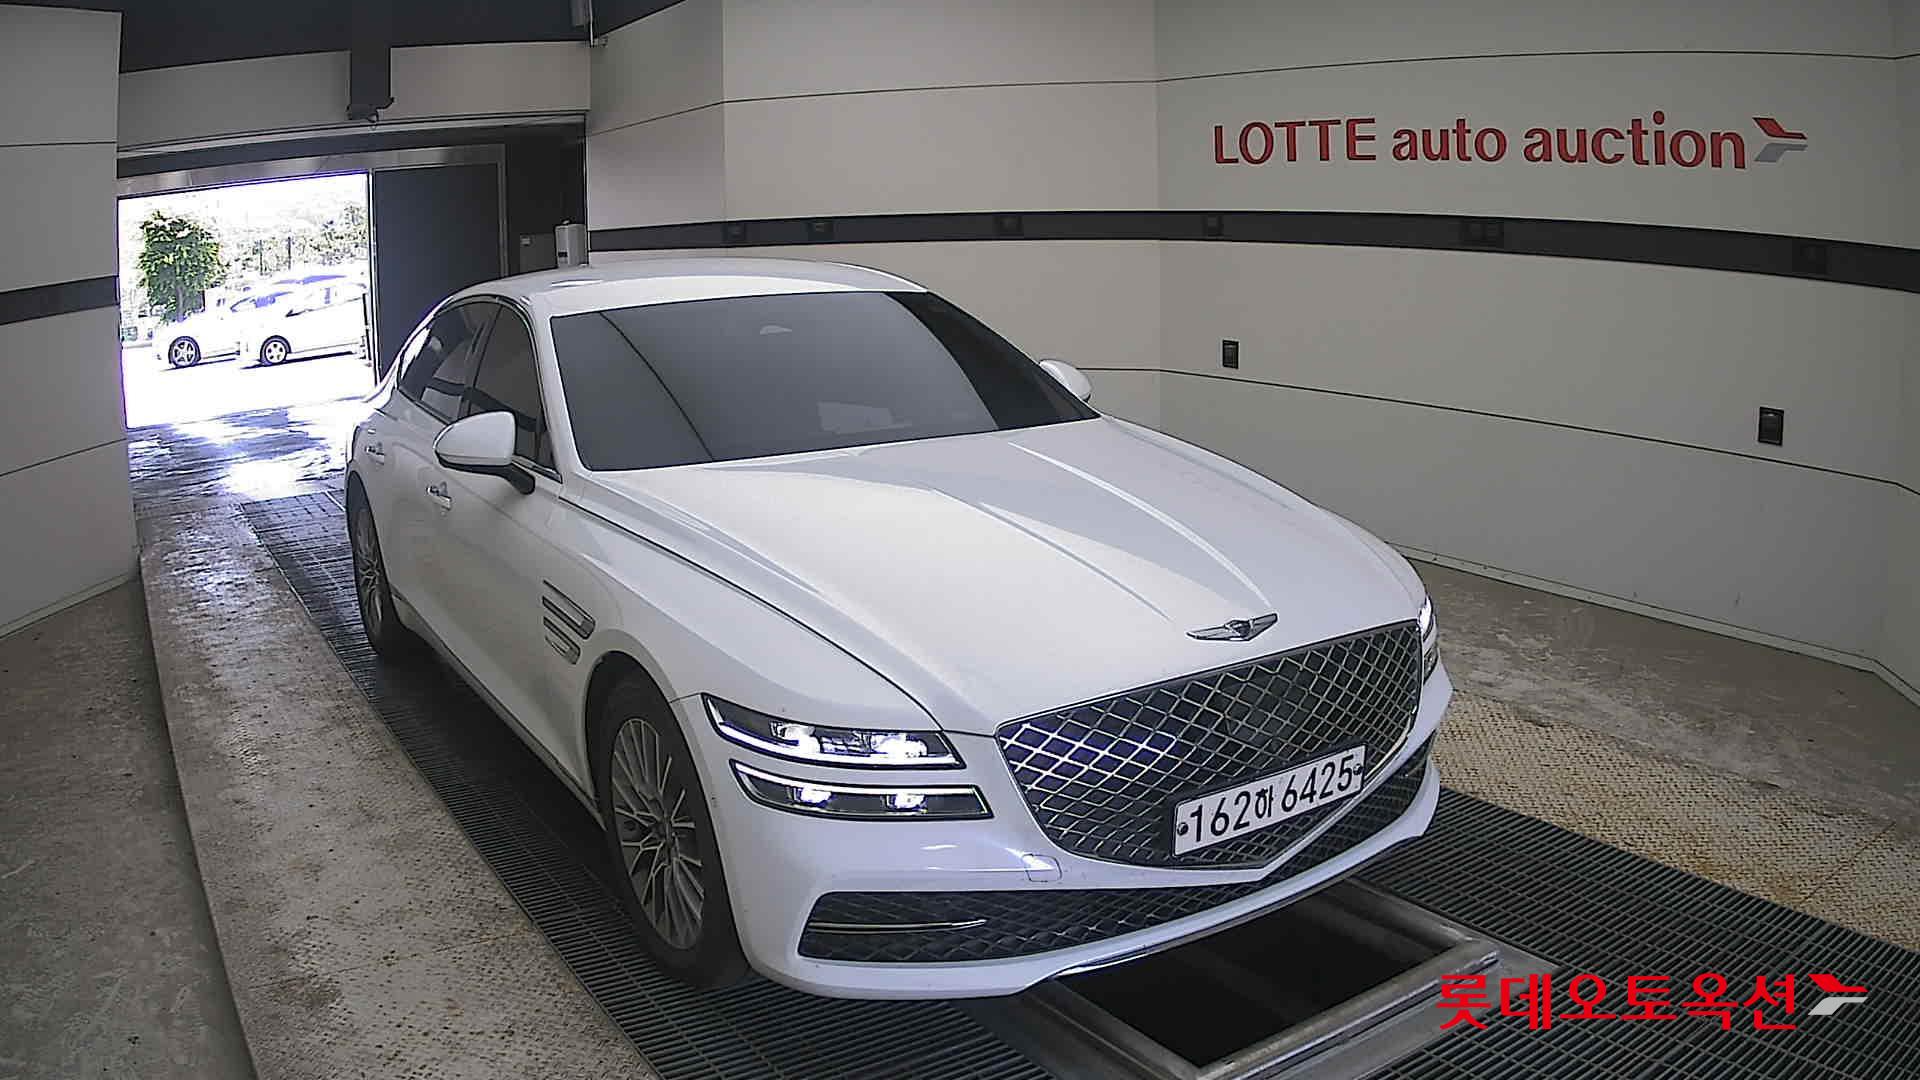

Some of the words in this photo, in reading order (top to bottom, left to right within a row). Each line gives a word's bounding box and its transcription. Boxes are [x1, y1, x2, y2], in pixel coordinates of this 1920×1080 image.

[1213, 117, 1377, 165] LOTTE
[1391, 118, 1508, 163] auto
[1522, 110, 1746, 169] auction
[1189, 784, 1275, 842] 162하
[1280, 754, 1355, 813] 6425
